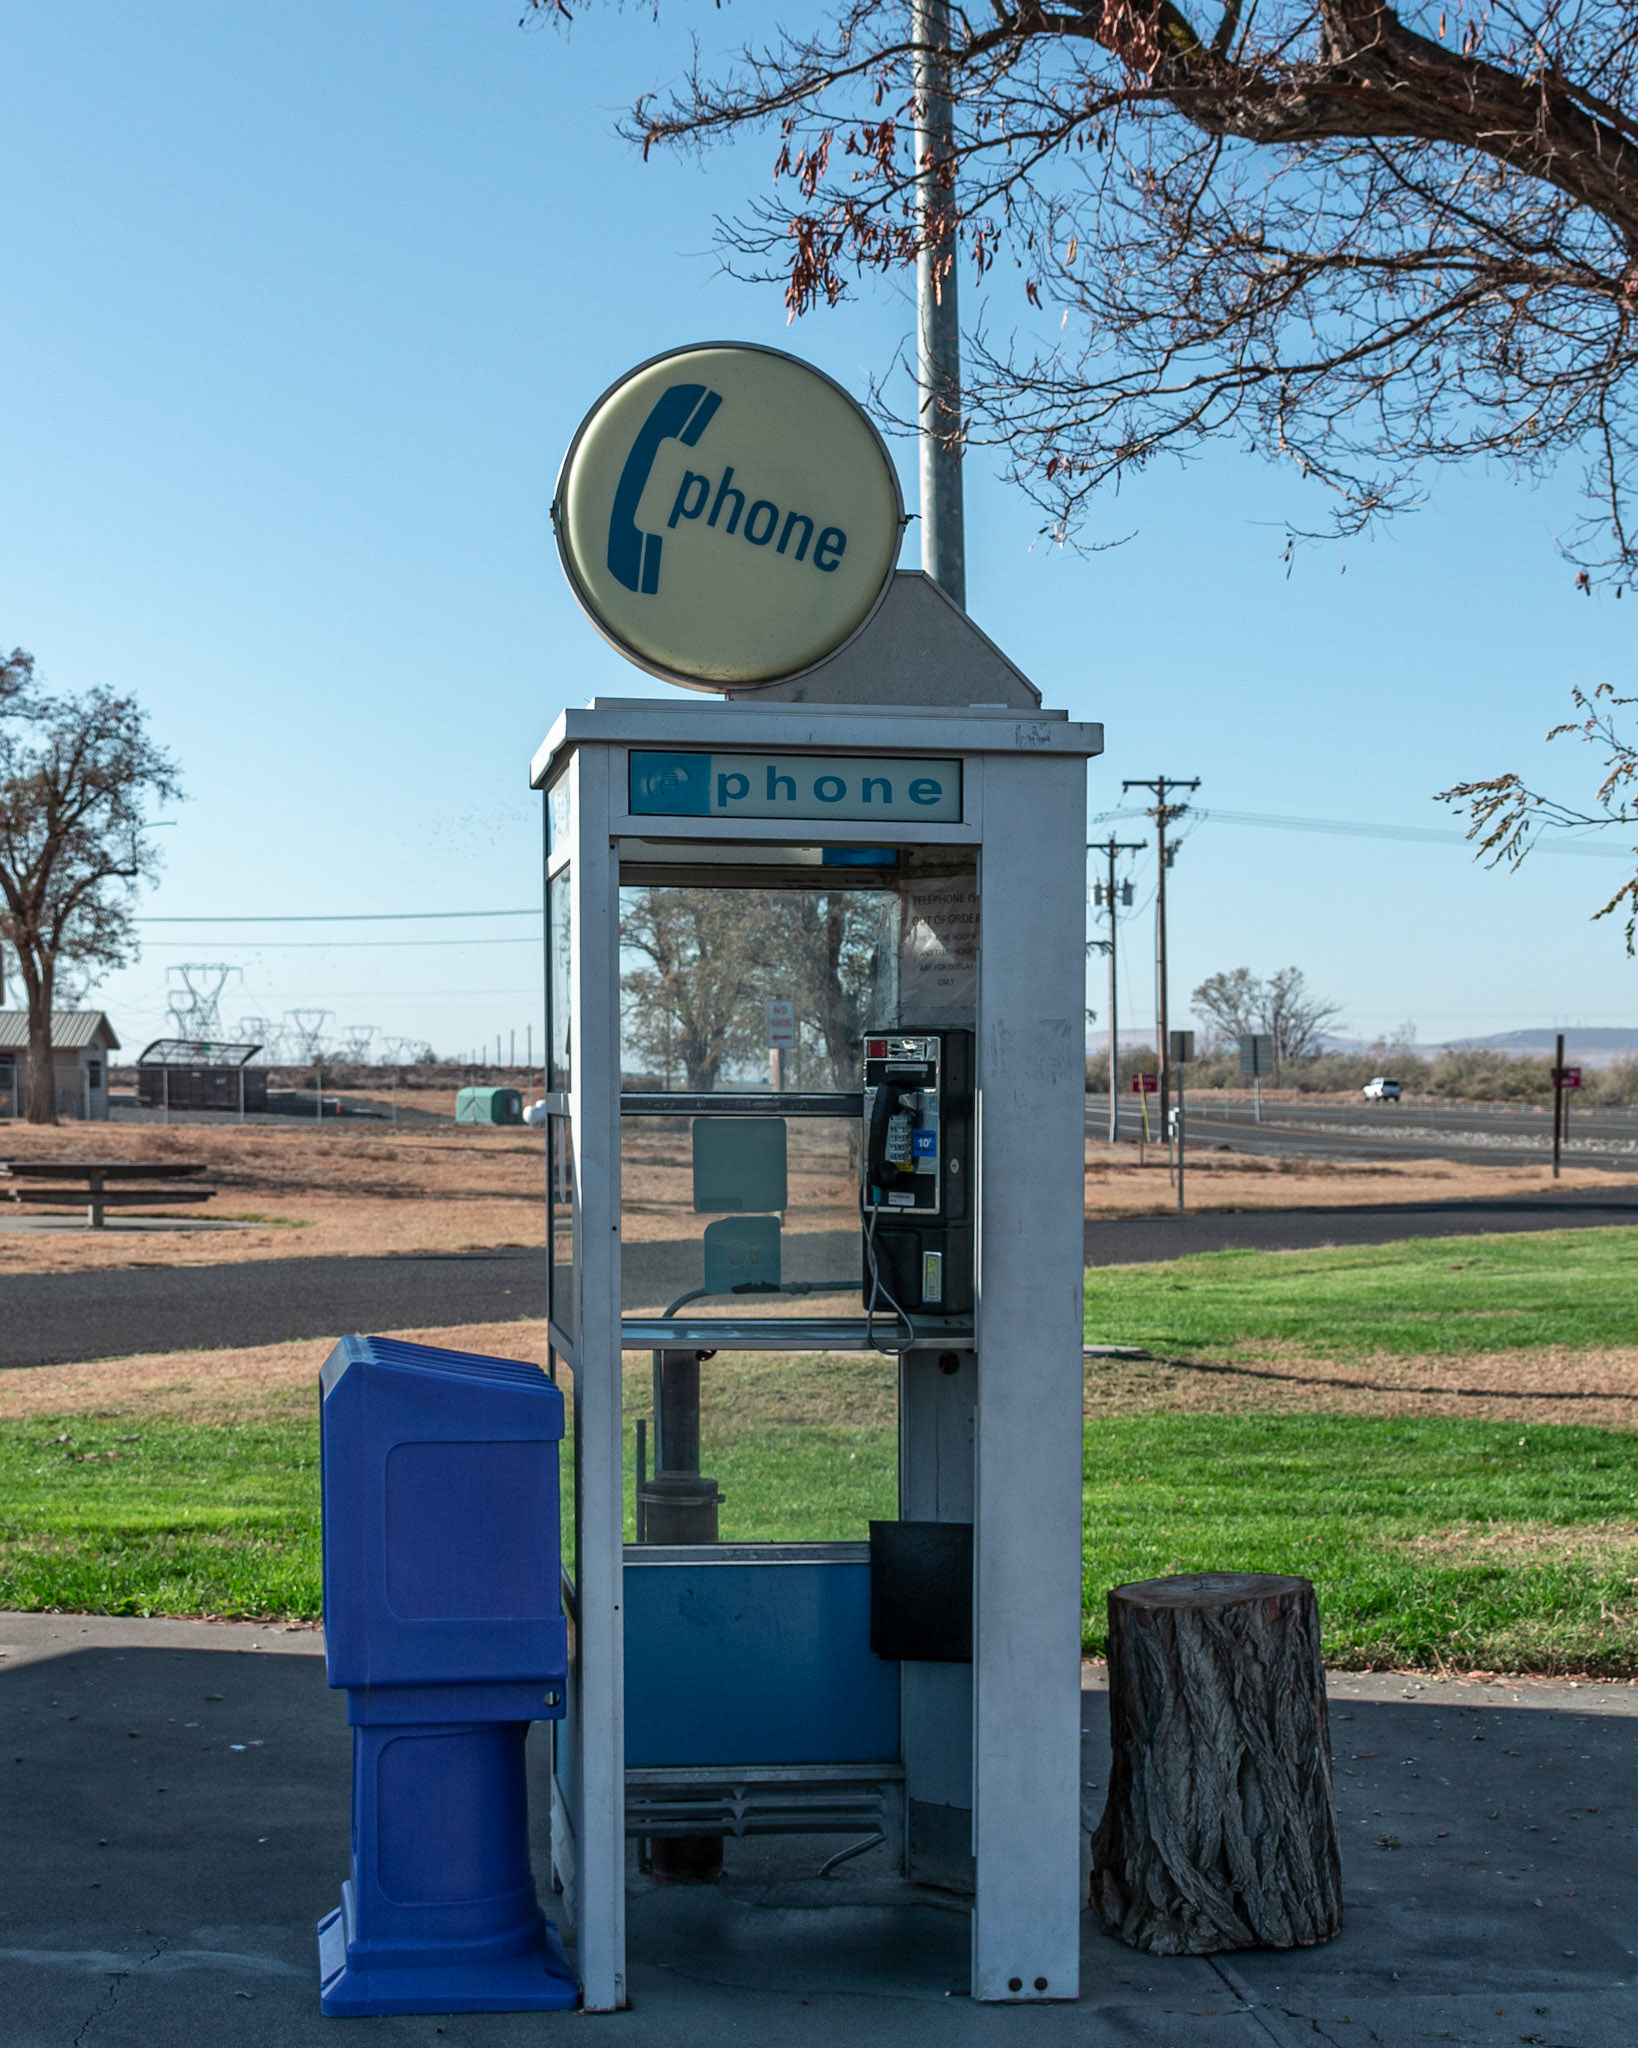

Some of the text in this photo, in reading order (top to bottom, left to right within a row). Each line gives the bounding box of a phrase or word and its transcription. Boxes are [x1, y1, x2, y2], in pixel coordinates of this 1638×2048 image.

[667, 465, 848, 573] phone
[717, 765, 943, 807] phone
[912, 893, 977, 906] TELEPHONE IS
[934, 915, 946, 925] OF
[948, 913, 980, 924] ORDER
[937, 978, 955, 986] ONLY
